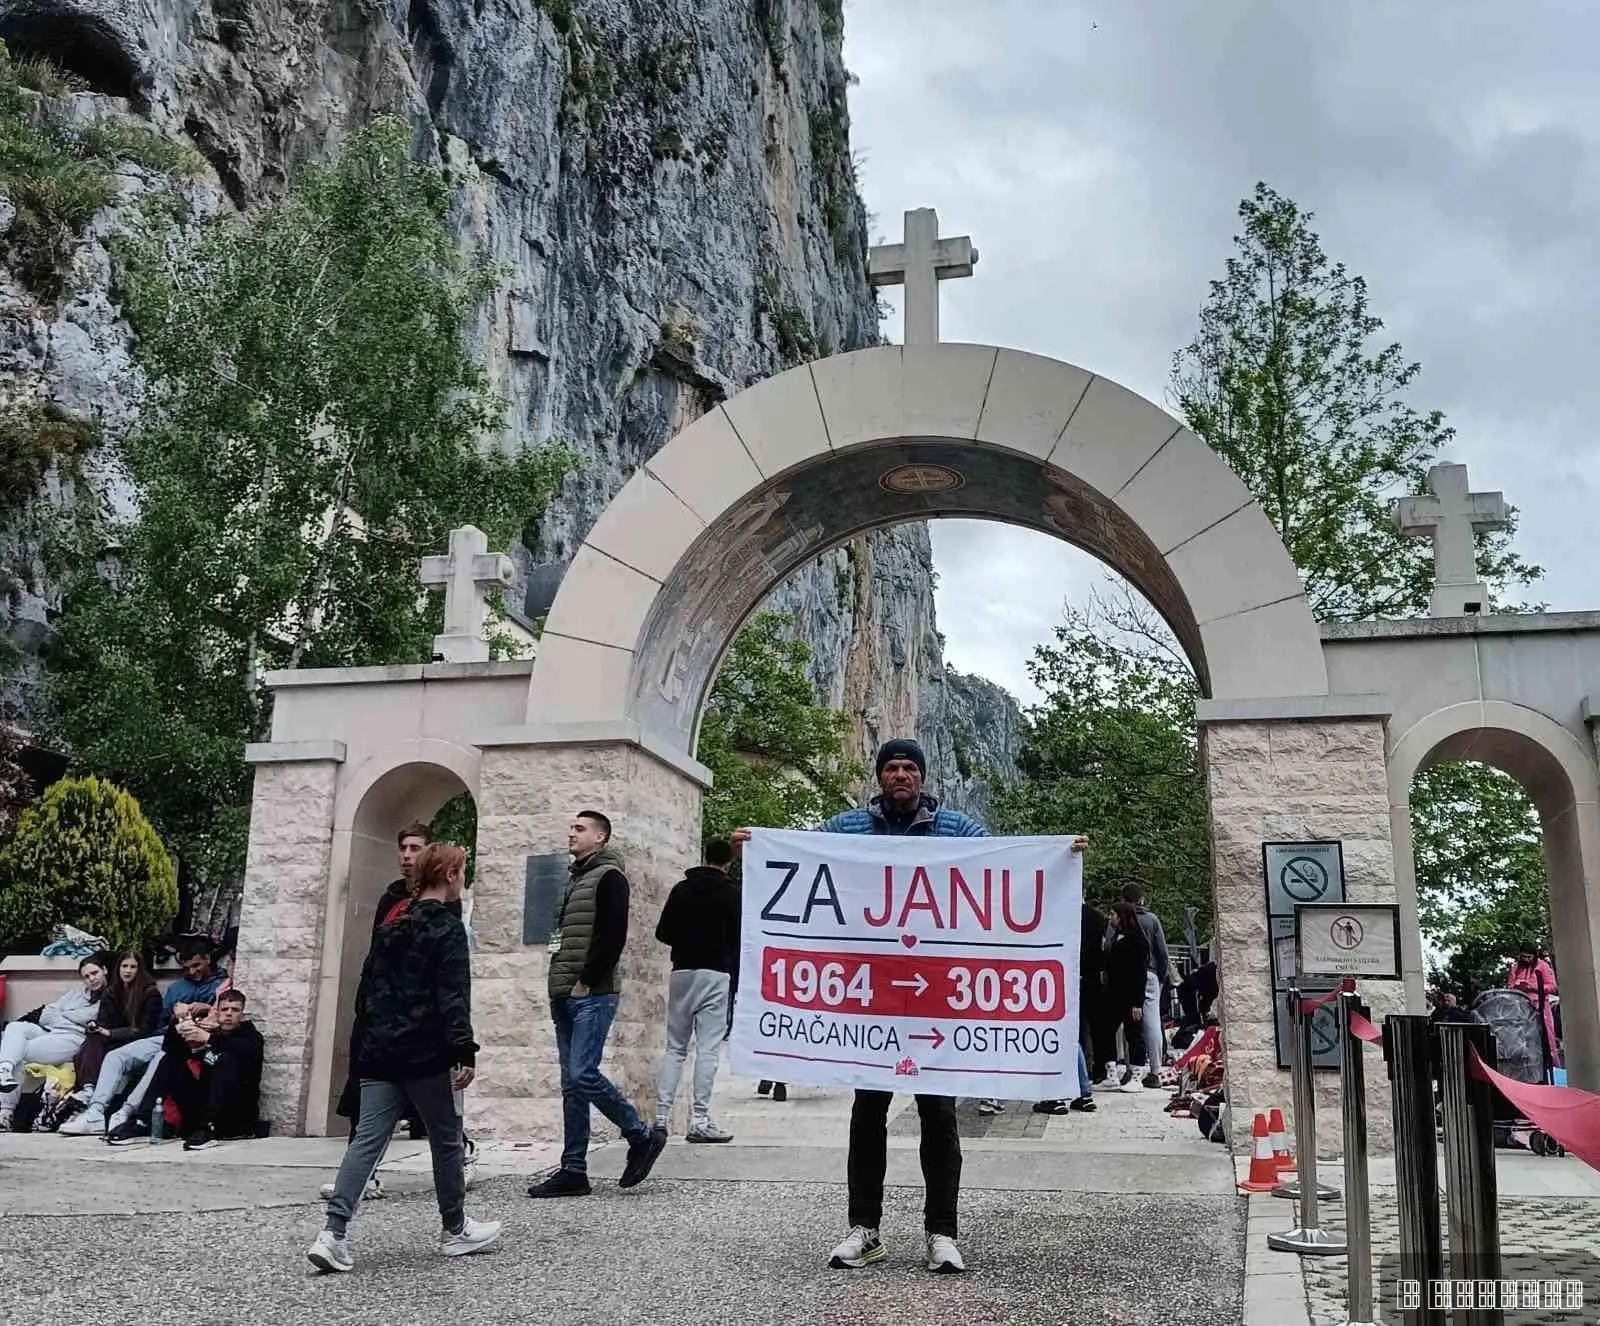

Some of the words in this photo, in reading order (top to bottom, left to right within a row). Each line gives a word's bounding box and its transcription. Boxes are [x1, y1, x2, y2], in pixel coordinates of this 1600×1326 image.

[760, 860, 847, 925] ZA
[863, 865, 1044, 933] JANU
[769, 958, 874, 1007] 1964
[946, 966, 1056, 1014] 3030
[759, 1011, 901, 1052] GRAČANICA
[953, 1025, 1060, 1054] OSTROG
